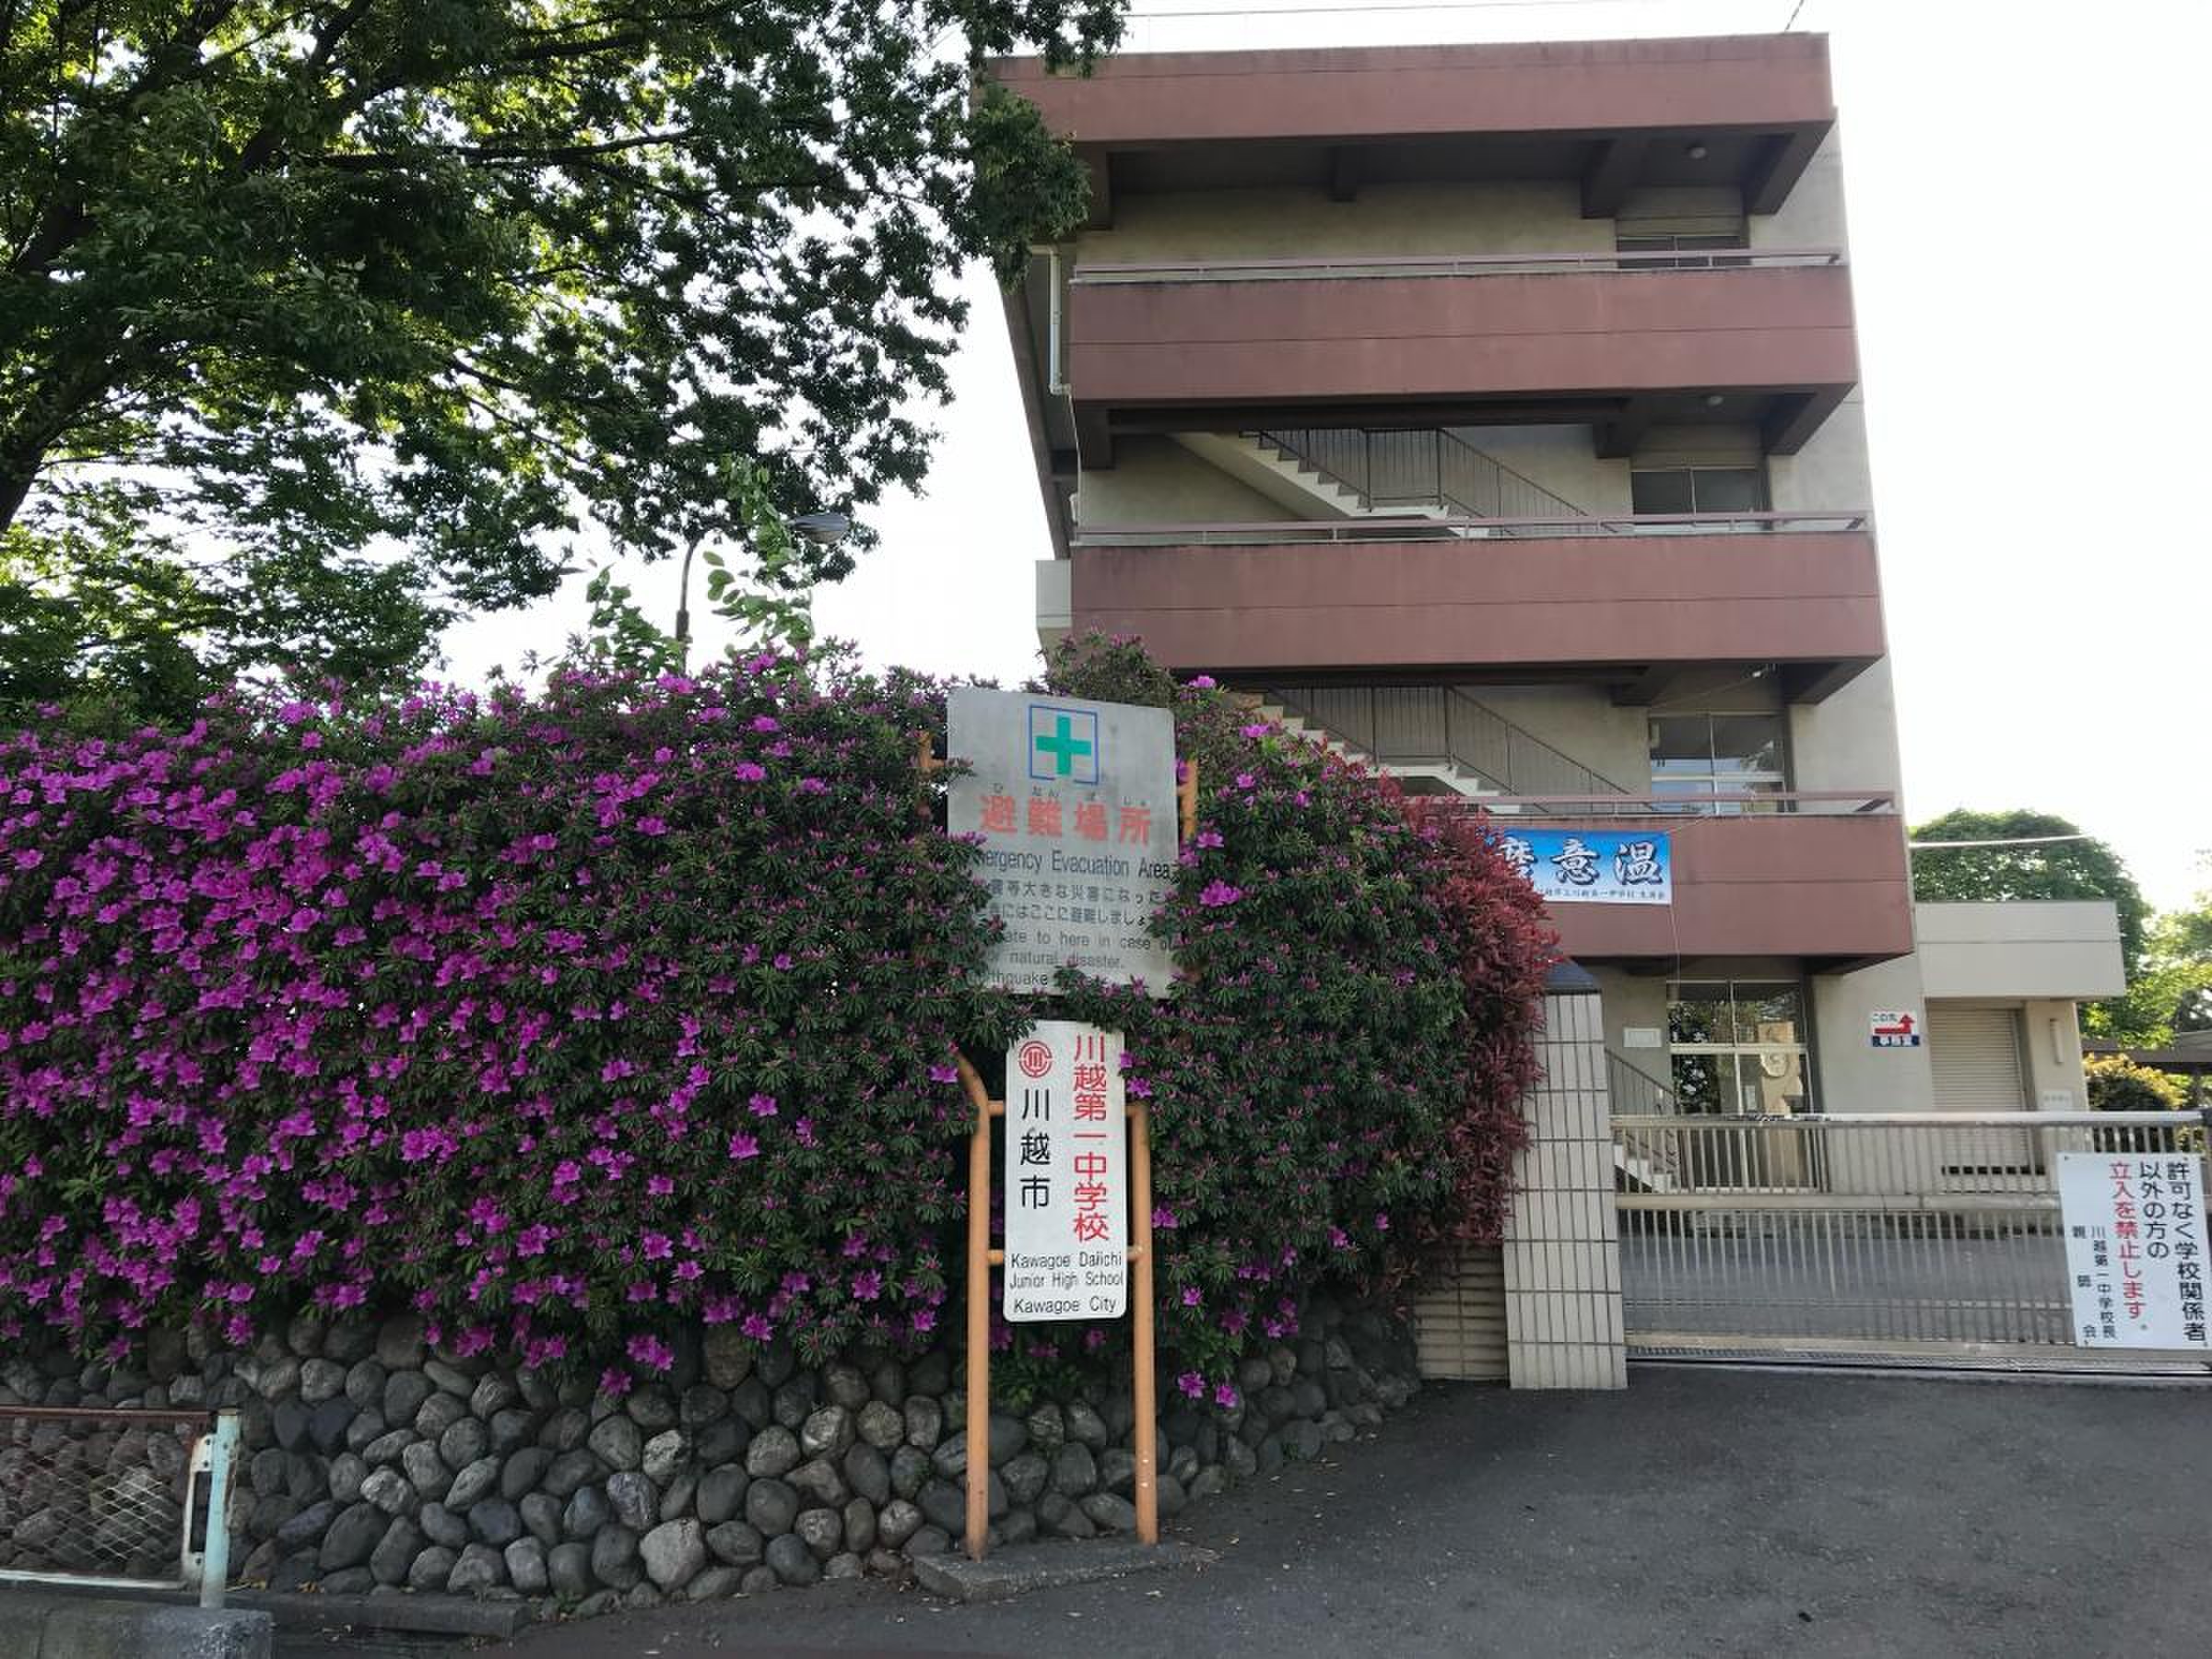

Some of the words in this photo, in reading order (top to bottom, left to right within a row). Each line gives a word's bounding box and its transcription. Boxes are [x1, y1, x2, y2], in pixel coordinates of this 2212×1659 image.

[979, 795, 1151, 846] 避難場所
[981, 851, 1042, 873] ergency
[1052, 850, 1129, 877] Evacuation
[1138, 857, 1171, 878] Area
[1037, 931, 1051, 944] to
[1060, 931, 1089, 947] here
[1120, 937, 1150, 951] case
[1009, 952, 1058, 965] natural
[1019, 1088, 1051, 1210] 川越市
[1073, 1034, 1110, 1242] 川越第一中学校
[2139, 1161, 2170, 1259] 以外の方の
[1011, 1253, 1071, 1269] Kawagoe
[1078, 1251, 1122, 1268] Daiichi
[2166, 1161, 2206, 1342] 許可なく学校関係者
[1010, 1272, 1045, 1289] Junior
[1052, 1272, 1077, 1290] High
[1085, 1270, 1123, 1287] School
[1014, 1297, 1080, 1314] Kawagoe
[1089, 1295, 1117, 1313] City
